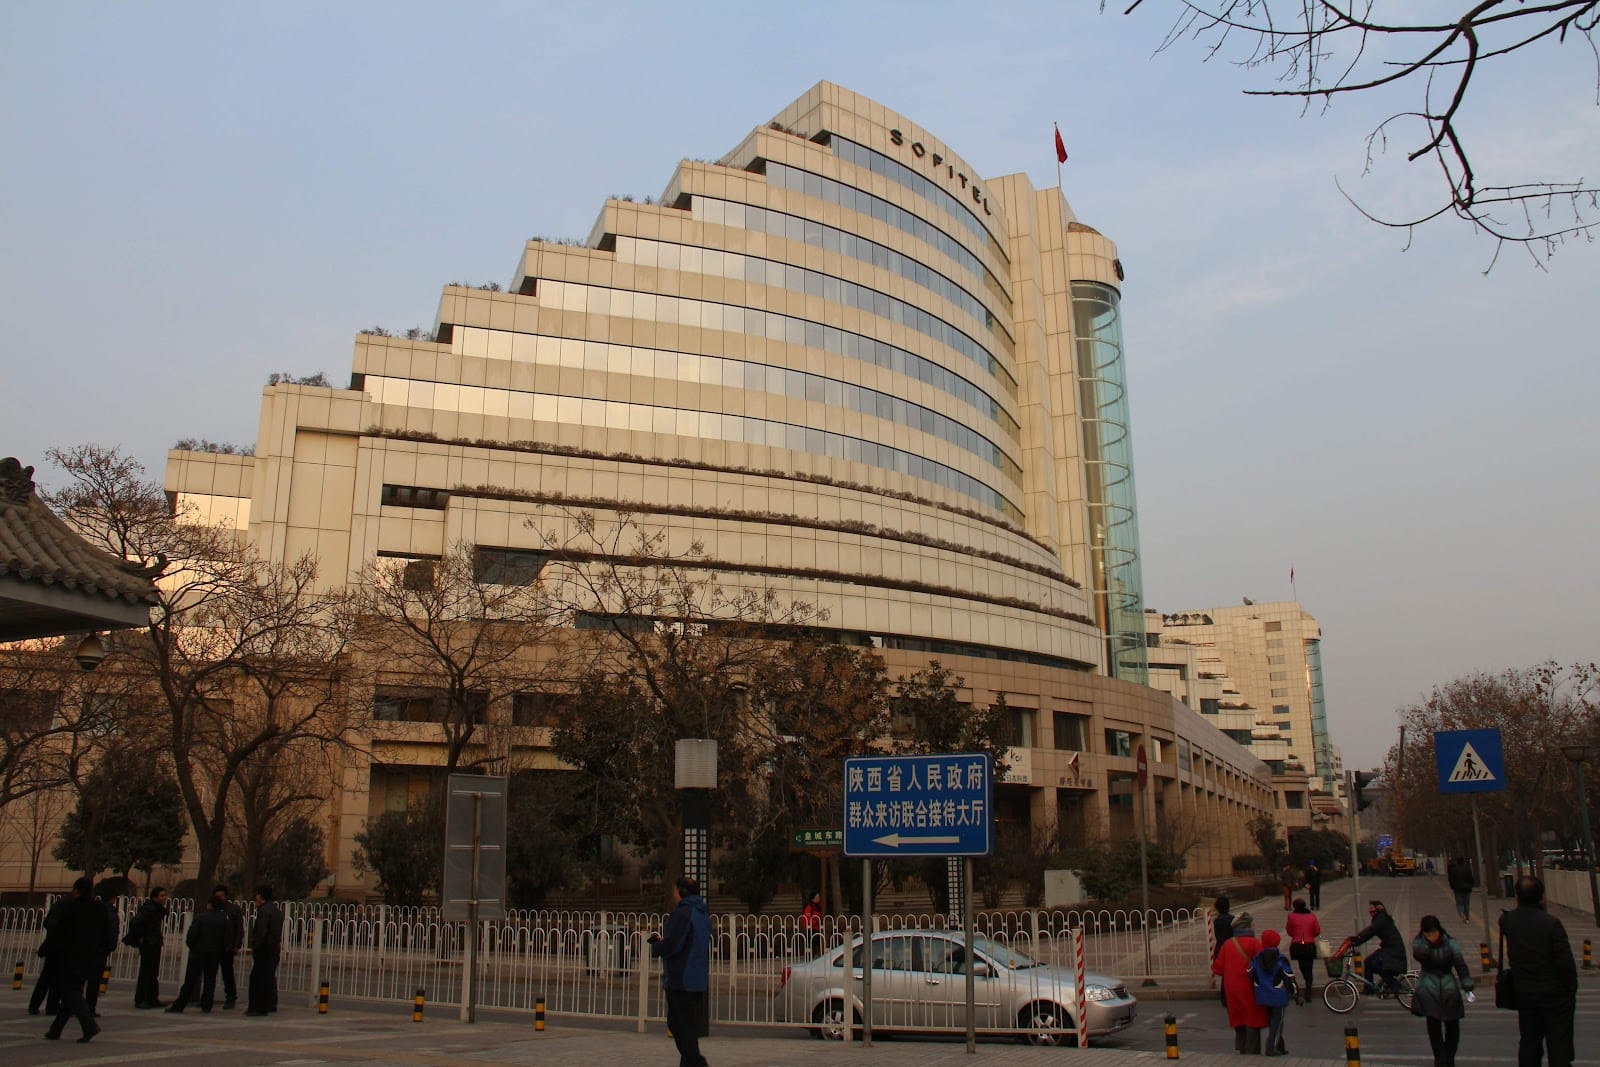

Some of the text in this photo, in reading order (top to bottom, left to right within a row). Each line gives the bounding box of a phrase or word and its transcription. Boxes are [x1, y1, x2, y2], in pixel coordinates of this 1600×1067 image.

[890, 128, 992, 216] SOFITEL
[849, 762, 983, 793] 陕西省人民政府
[849, 799, 984, 828] 群众来访联合接待大厅
